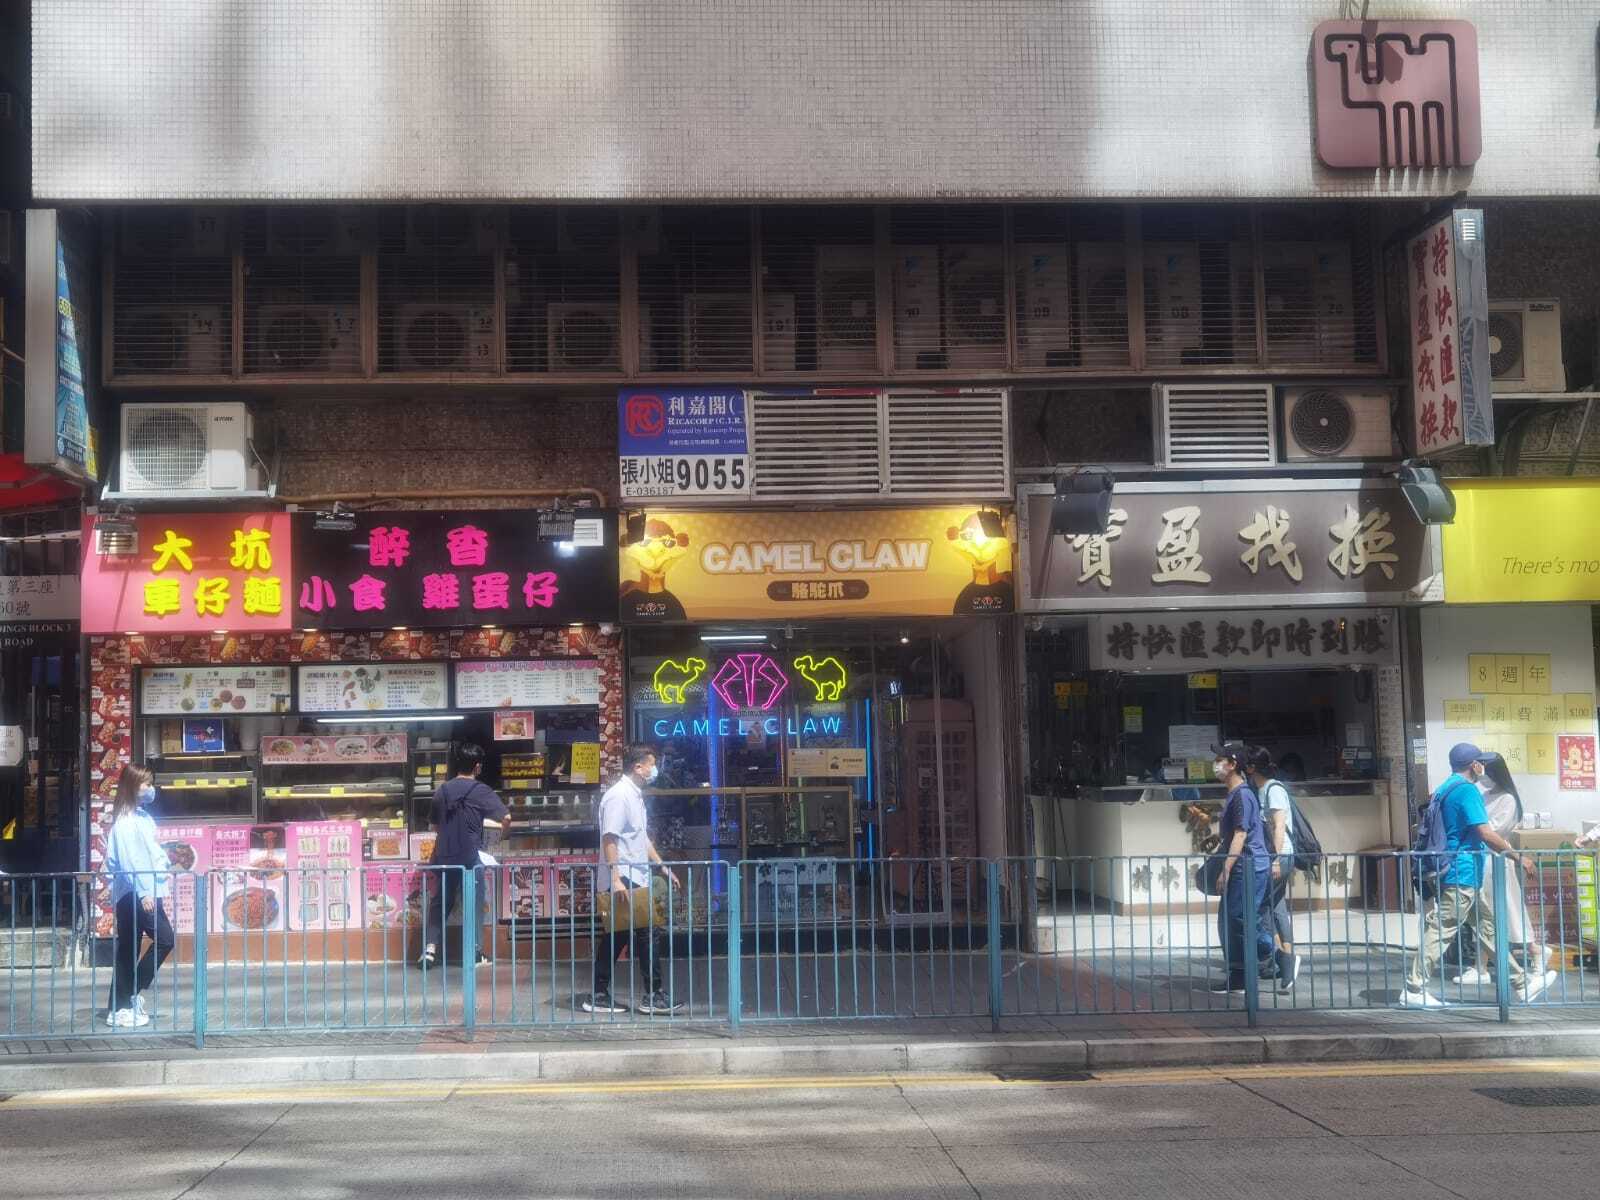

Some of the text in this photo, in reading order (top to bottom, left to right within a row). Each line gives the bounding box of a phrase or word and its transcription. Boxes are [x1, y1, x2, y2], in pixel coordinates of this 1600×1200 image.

[669, 417, 715, 425] RICACORP
[621, 458, 675, 484] 張小姐
[677, 458, 745, 490] 9055
[626, 487, 674, 497] E-036187
[151, 528, 272, 573] 大坑
[368, 525, 488, 567] 醉香
[702, 540, 930, 574] CAMEL CLAW
[1503, 556, 1565, 574] There's
[0, 579, 56, 595] 第三座
[299, 572, 559, 612] 小食 雞蛋仔
[791, 582, 845, 600] 駱駝爪
[144, 577, 282, 617] 車仔麵
[29, 624, 63, 633] BLOCK
[4, 638, 34, 647] ROAD
[1479, 665, 1546, 684] 8週年
[654, 717, 842, 737] CAMEL CLAW
